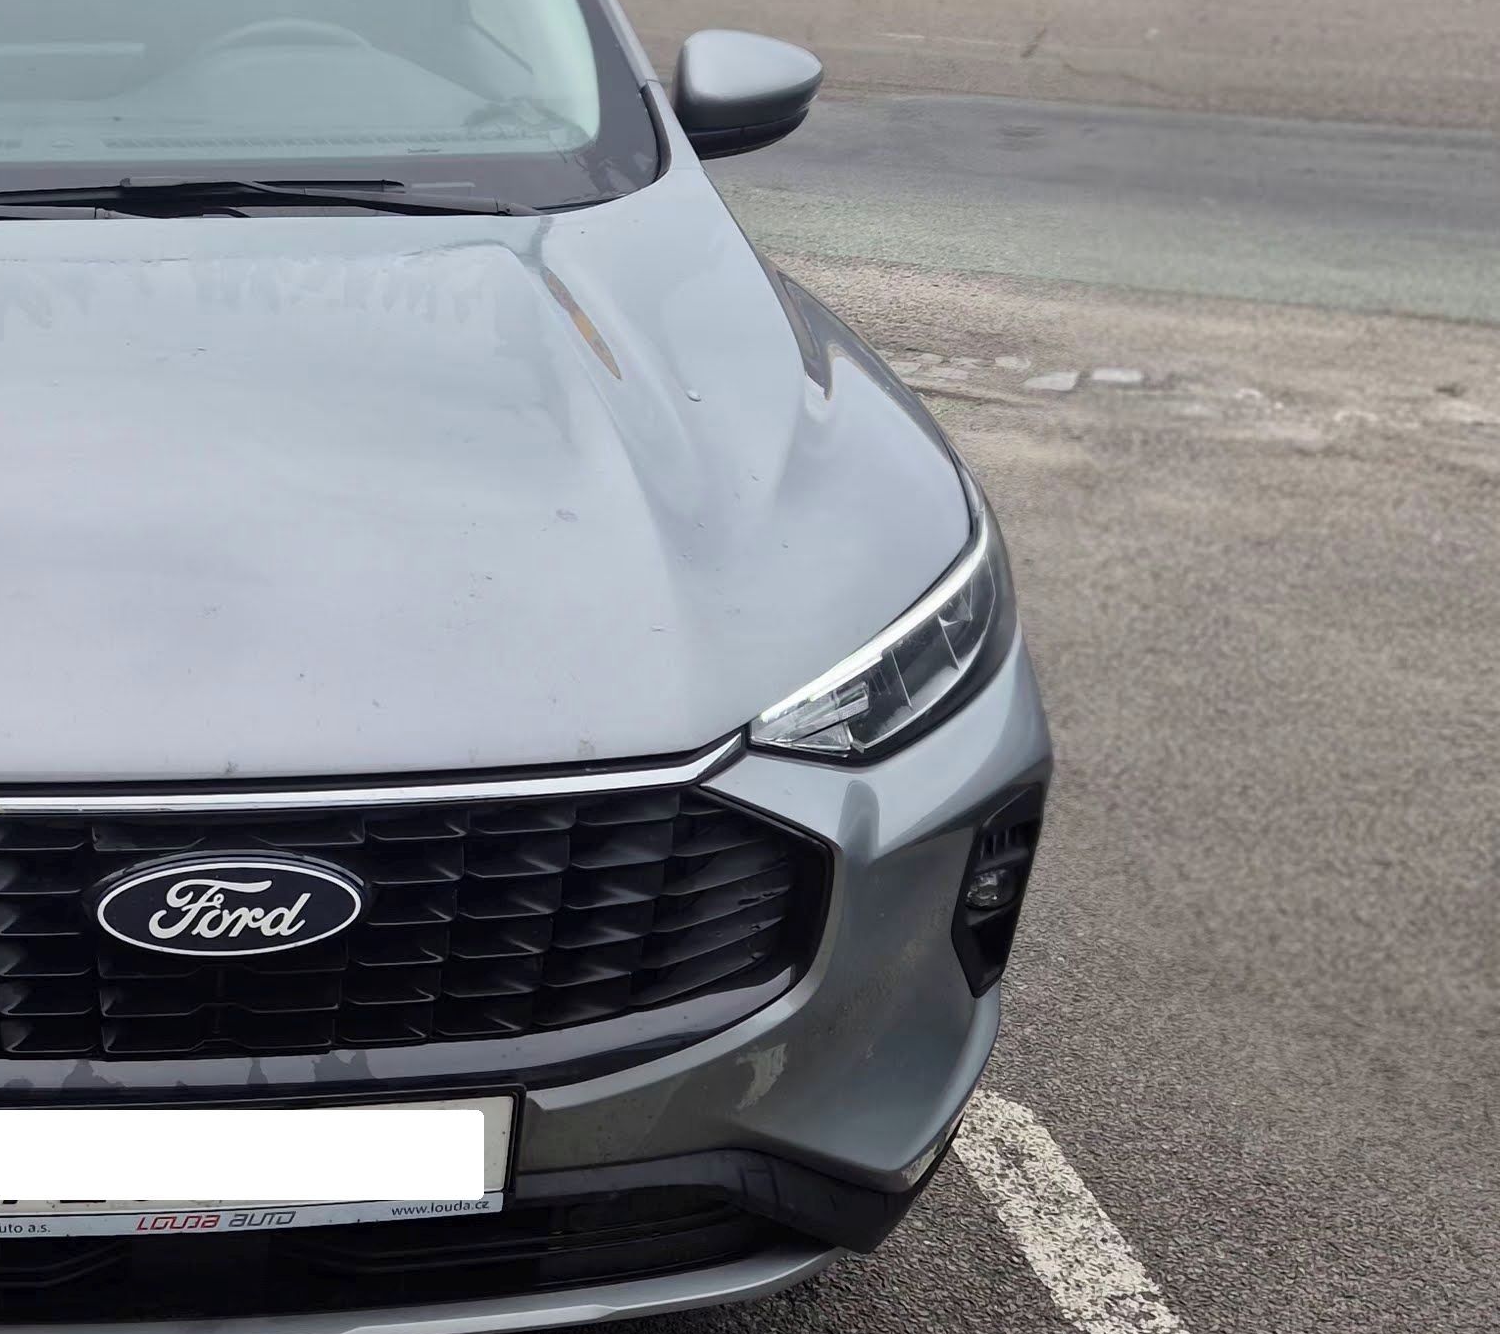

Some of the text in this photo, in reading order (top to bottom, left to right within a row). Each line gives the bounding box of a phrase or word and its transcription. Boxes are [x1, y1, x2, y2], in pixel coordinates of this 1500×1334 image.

[148, 878, 312, 939] Ford
[391, 1199, 490, 1216] www.louda.cz
[27, 1221, 51, 1234] a.s.
